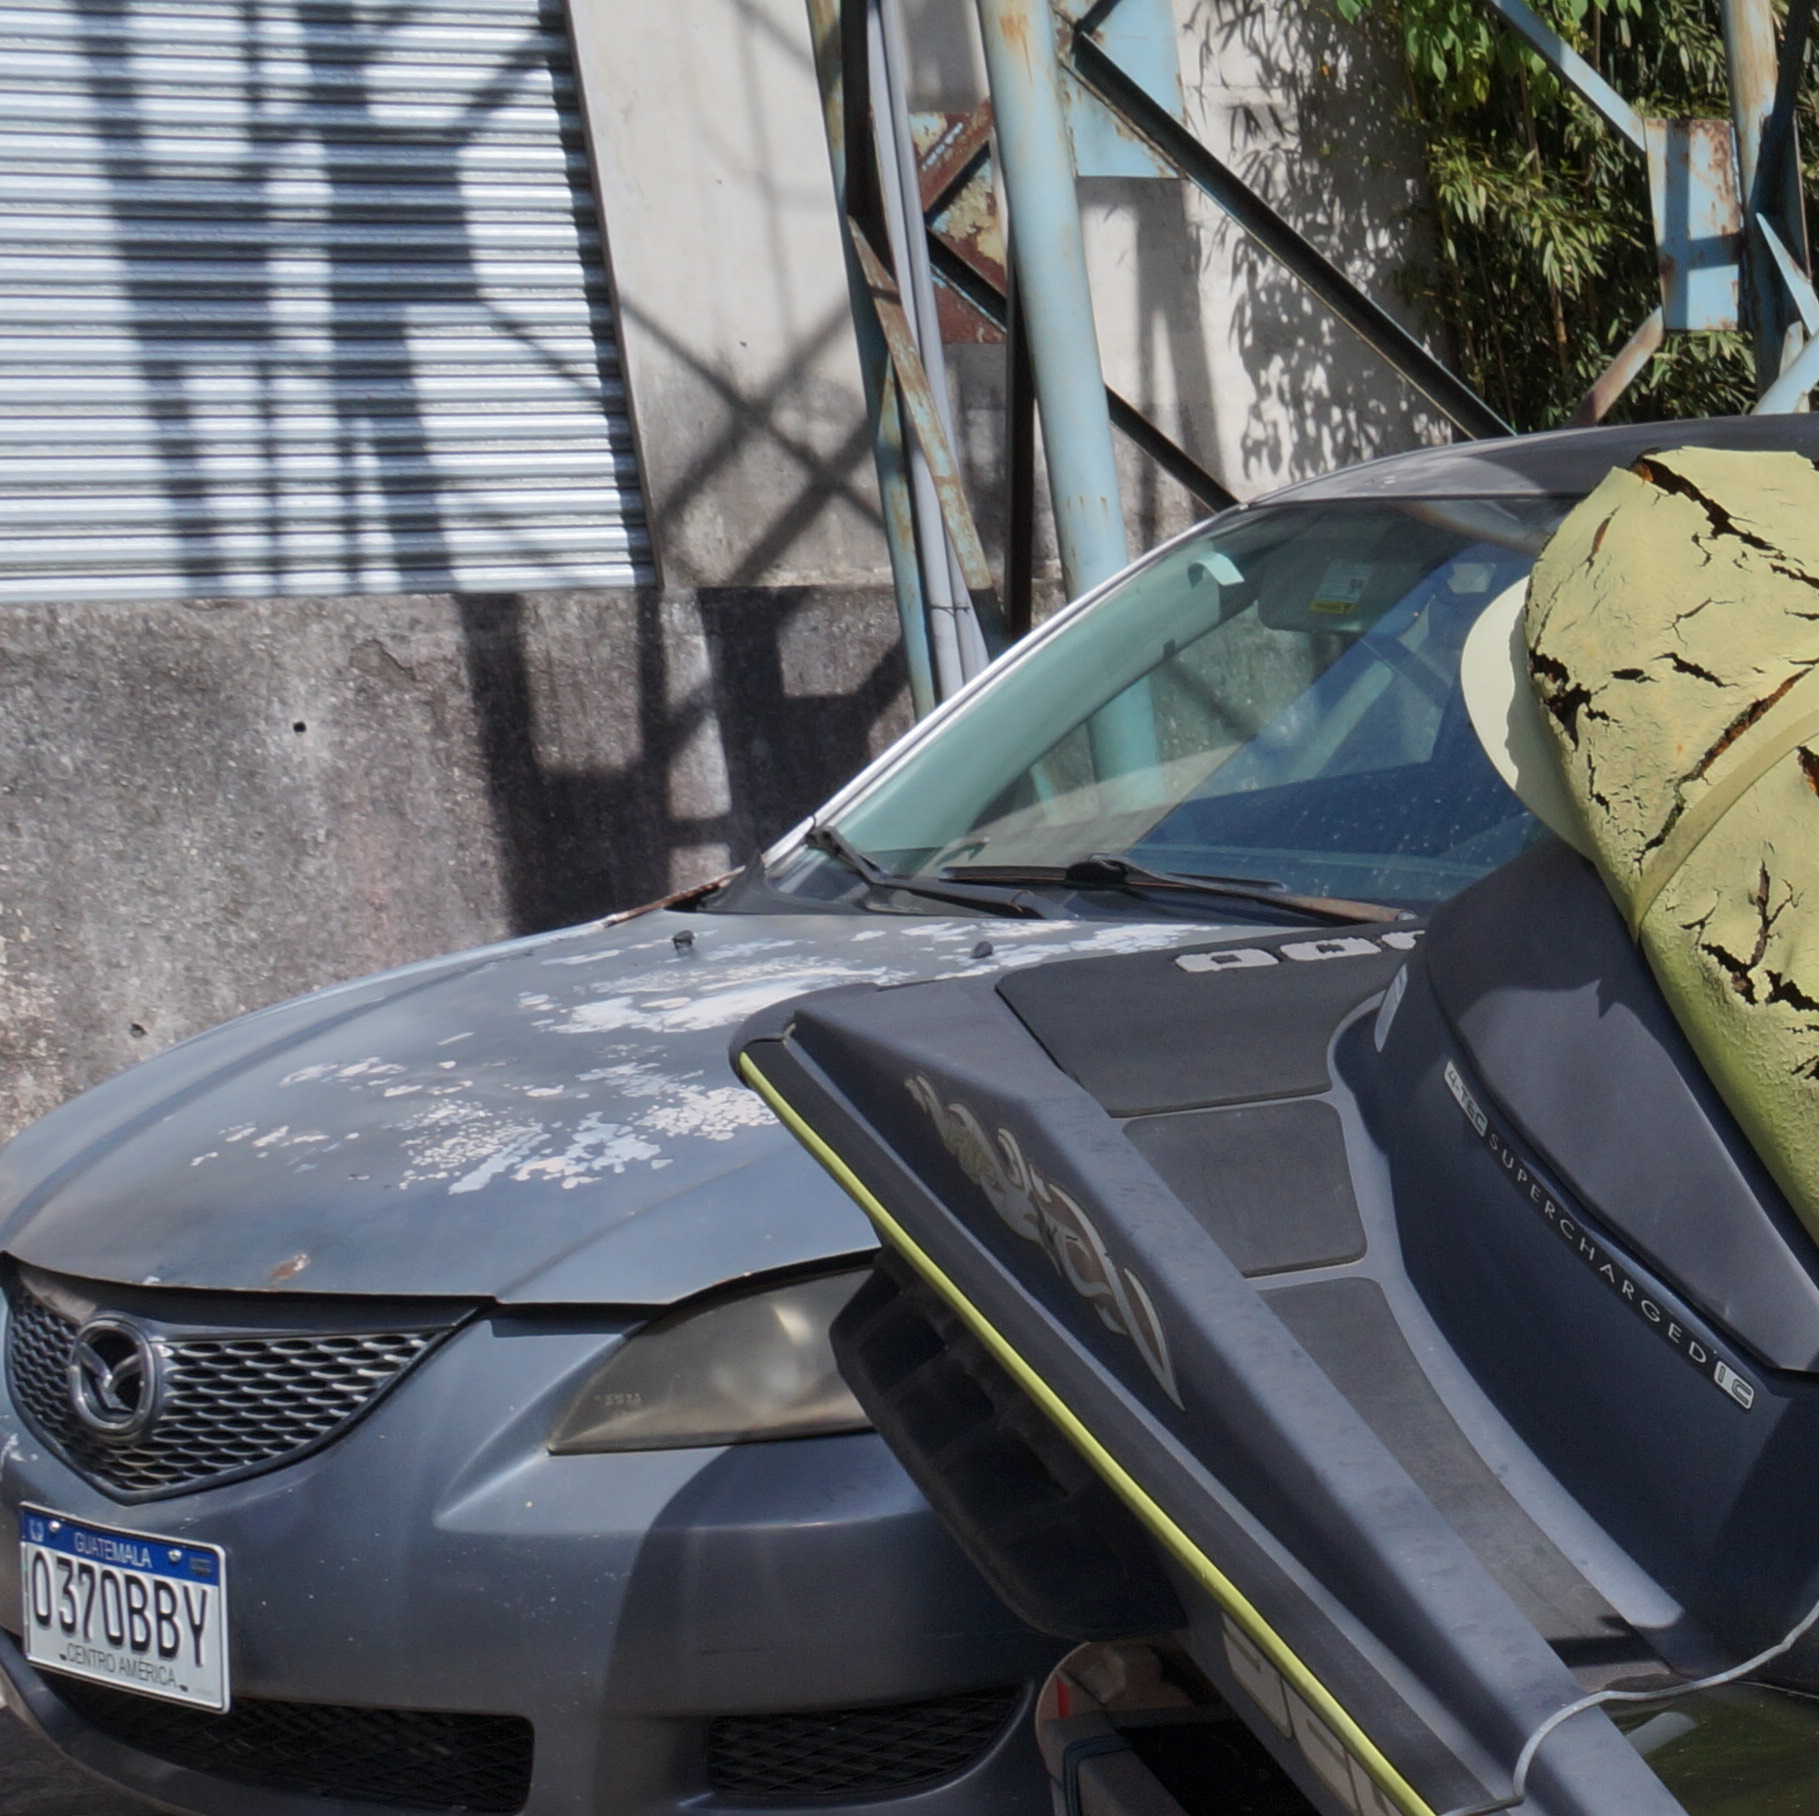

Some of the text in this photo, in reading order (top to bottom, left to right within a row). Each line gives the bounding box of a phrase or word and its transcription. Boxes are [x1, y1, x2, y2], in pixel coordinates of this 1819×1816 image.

[1488, 1132, 1707, 1364] SUPERCHARGED
[74, 1532, 153, 1569] GUATEMALA
[66, 1642, 116, 1673] CENTRO
